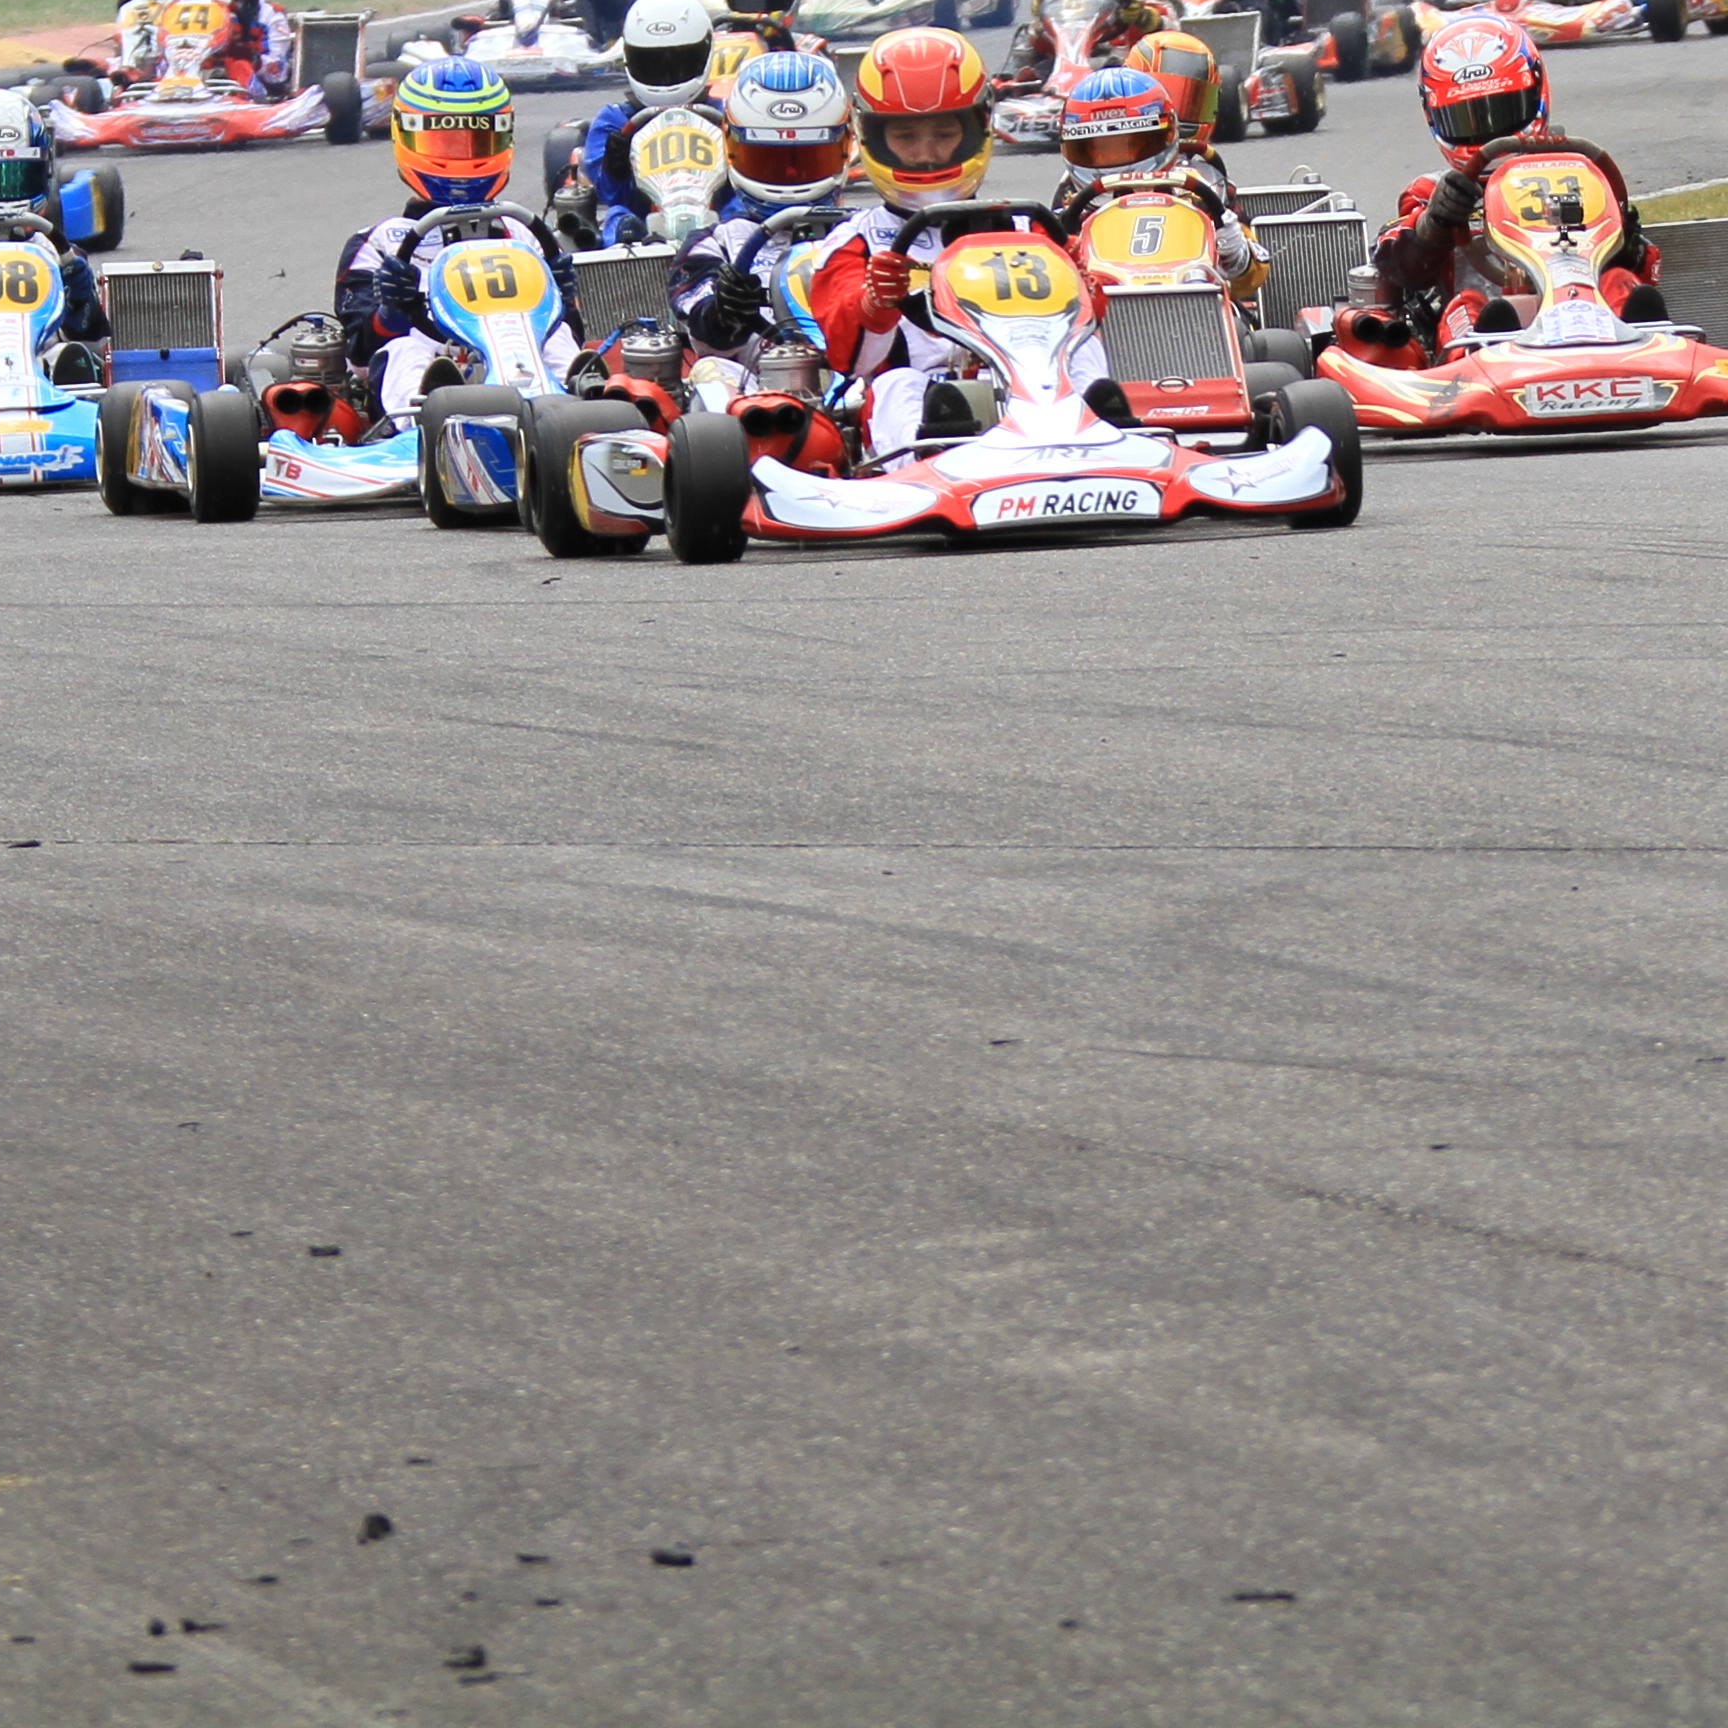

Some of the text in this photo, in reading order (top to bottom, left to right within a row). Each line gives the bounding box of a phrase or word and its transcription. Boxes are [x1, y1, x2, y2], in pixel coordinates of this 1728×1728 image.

[174, 6, 210, 31] 44
[647, 22, 677, 35] Arai
[1455, 65, 1491, 82] Arai
[770, 101, 804, 118] Arai
[1090, 107, 1127, 121] uvex
[430, 116, 491, 130] LOTUS
[642, 132, 714, 171] 106
[1518, 175, 1581, 221] 31
[1129, 215, 1166, 257] 5
[451, 254, 519, 303] 15
[980, 252, 1053, 301] 13
[1539, 394, 1641, 412] Racing
[272, 457, 302, 480] TB
[996, 490, 1139, 519] PM RACING
